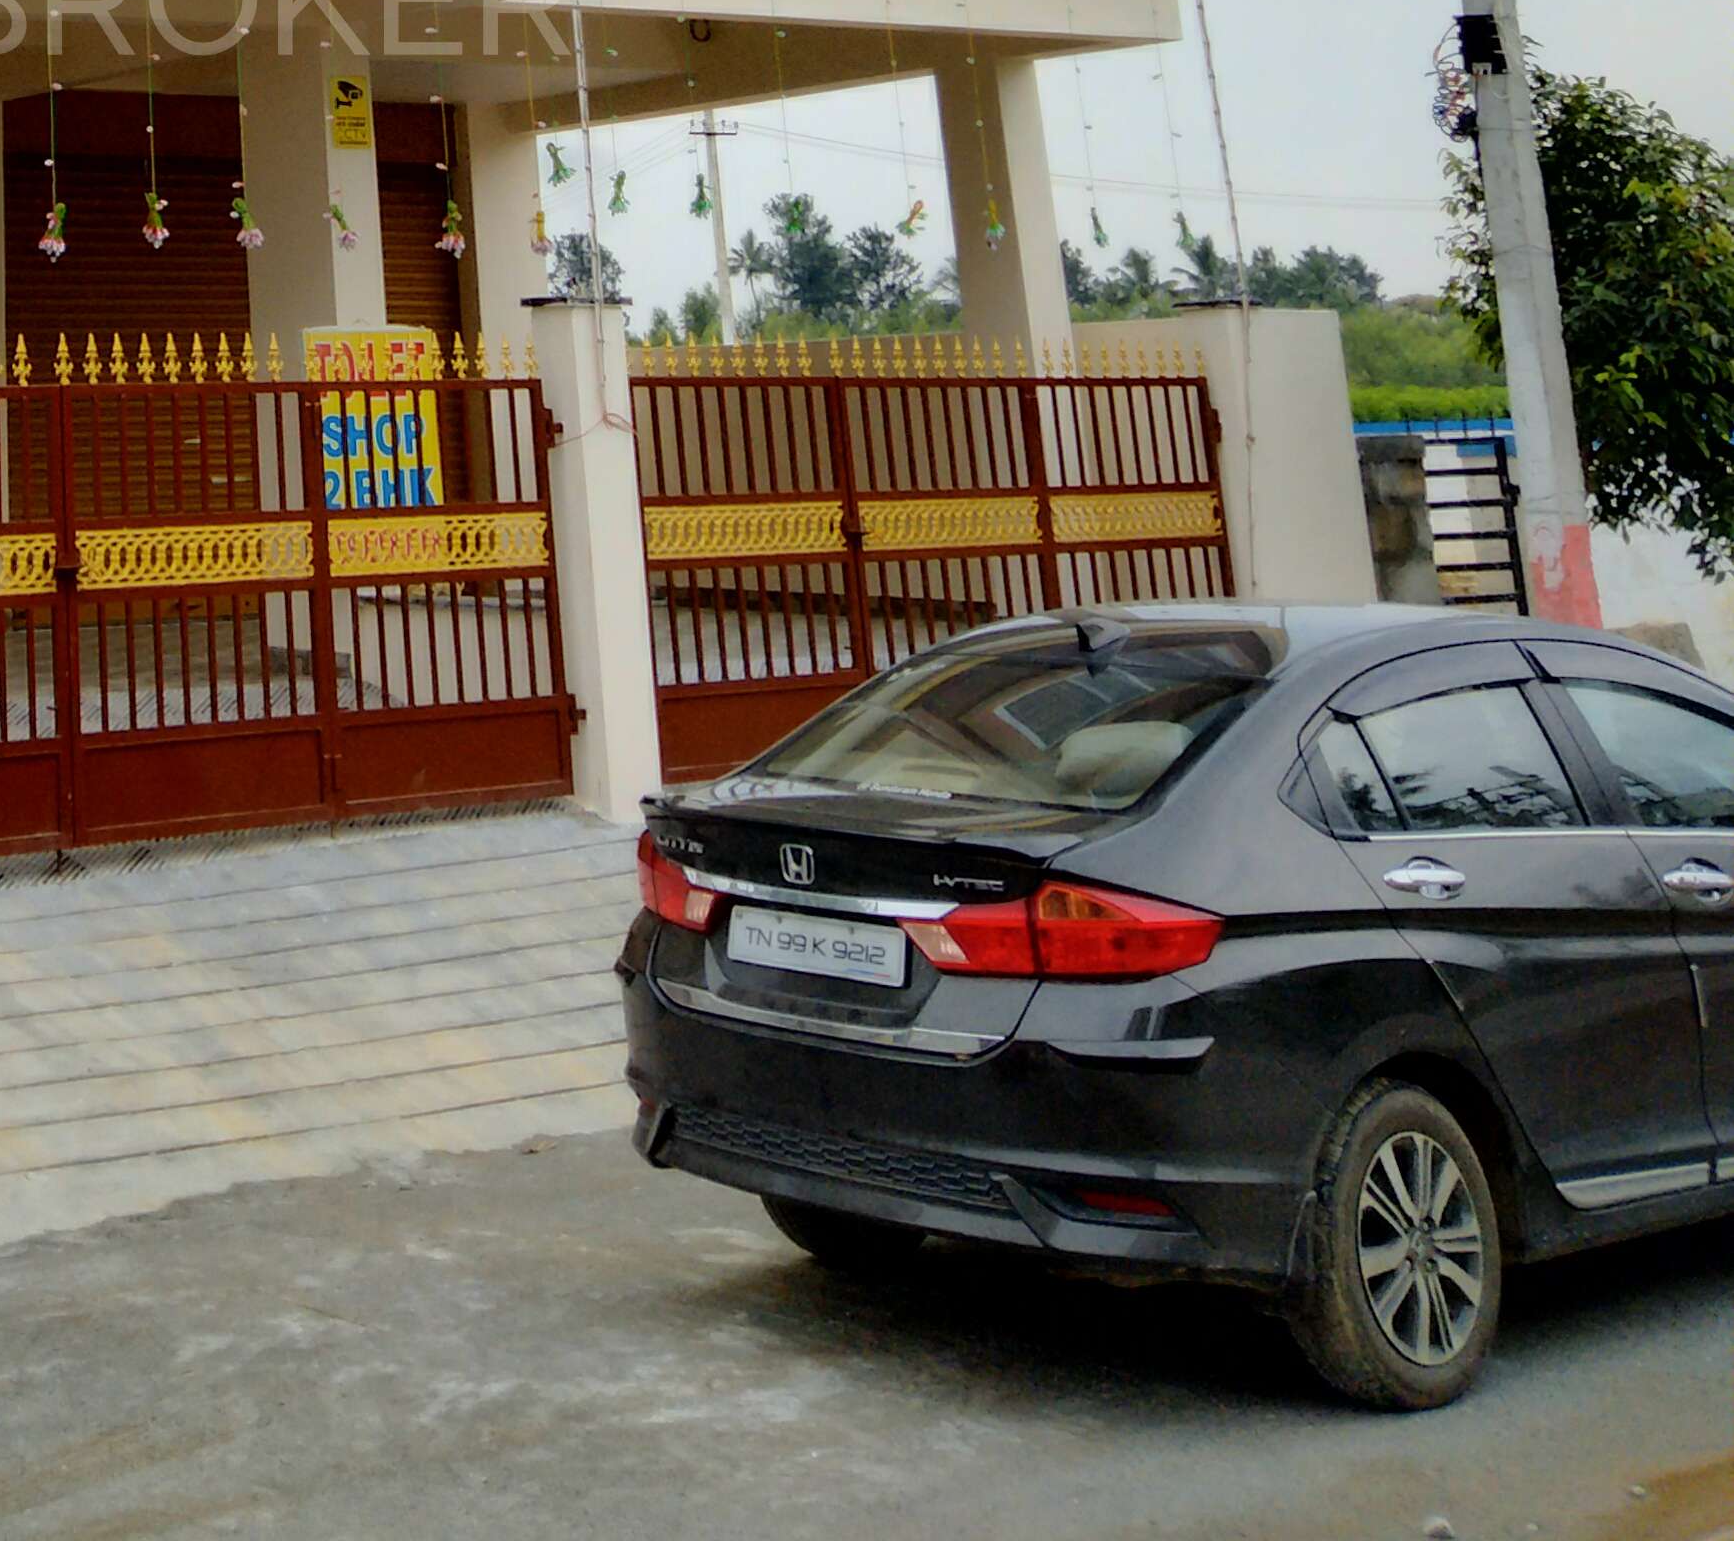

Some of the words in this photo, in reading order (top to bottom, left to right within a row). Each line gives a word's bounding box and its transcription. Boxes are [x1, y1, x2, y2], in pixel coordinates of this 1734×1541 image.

[322, 414, 425, 458] SHOP
[324, 469, 342, 511] 2
[354, 467, 436, 510] BHK
[745, 926, 773, 947] TN
[776, 932, 807, 953] 99
[812, 936, 826, 957] K
[832, 941, 886, 965] 9212
